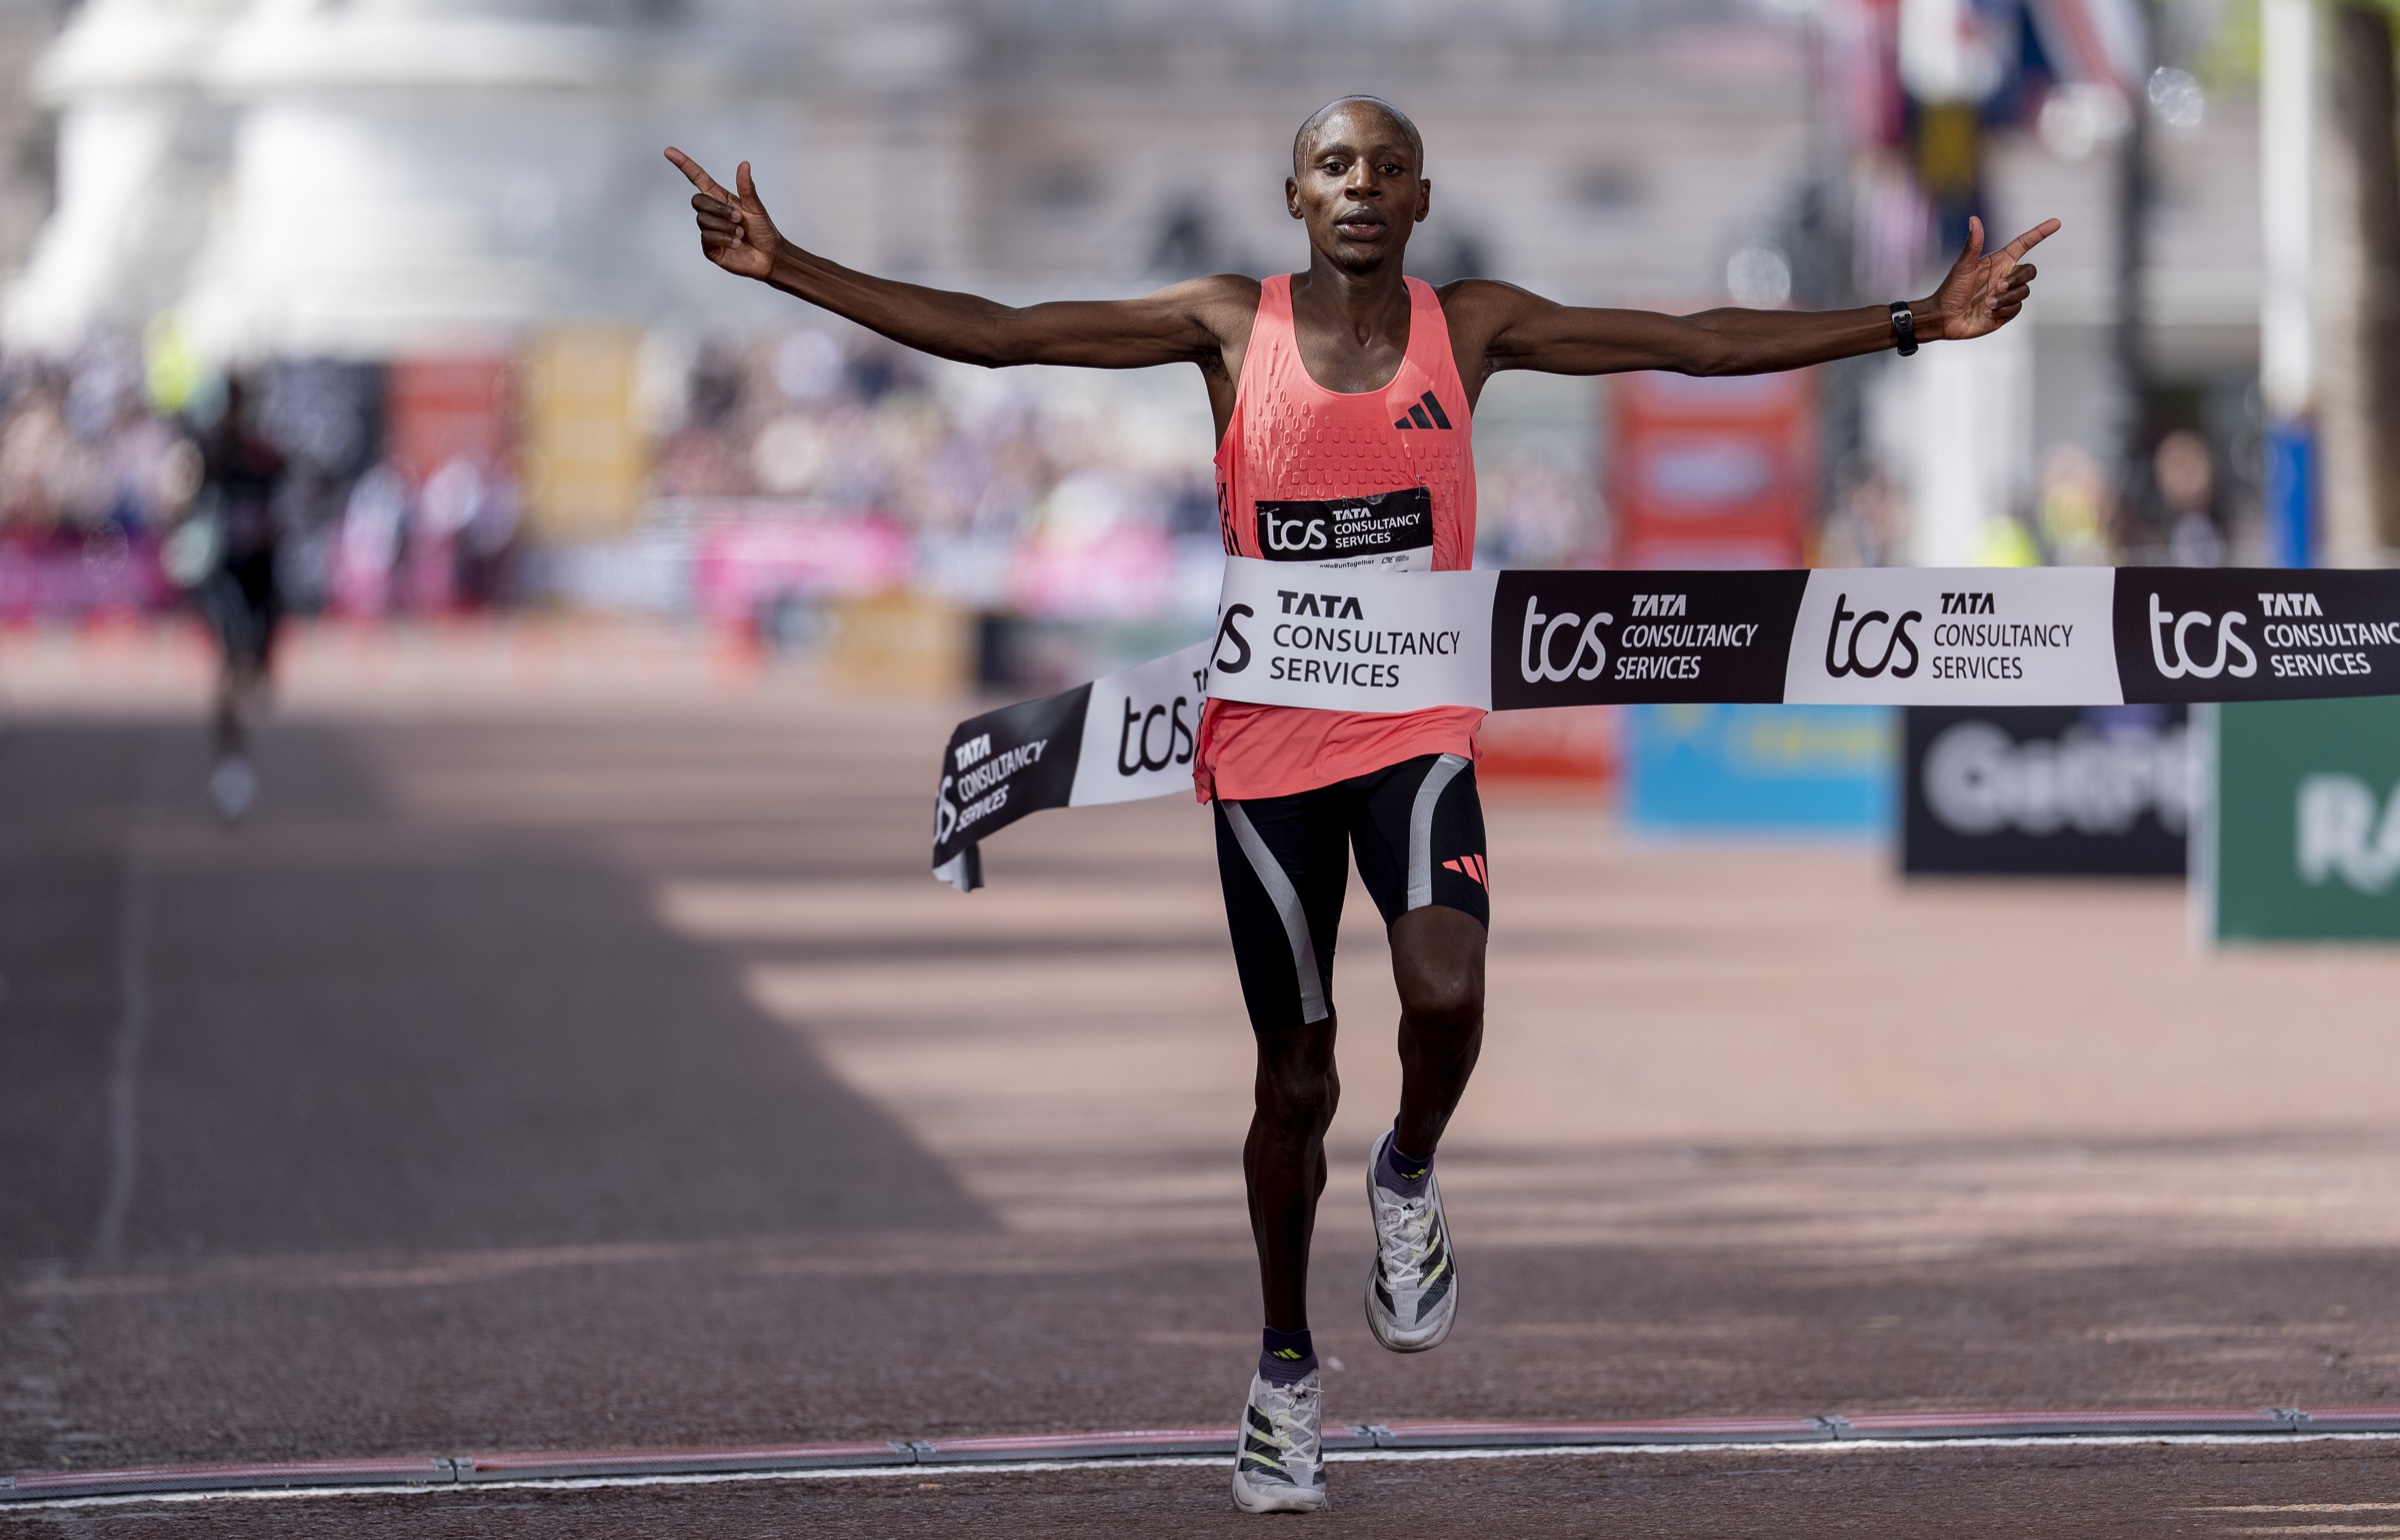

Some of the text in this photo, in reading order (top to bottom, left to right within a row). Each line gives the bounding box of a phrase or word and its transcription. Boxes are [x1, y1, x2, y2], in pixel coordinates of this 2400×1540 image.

[1333, 507, 1371, 521] TATA
[1334, 513, 1421, 535] CONSULTANCY
[1266, 511, 1327, 550] tcs
[1335, 532, 1391, 549] SERVICES
[1277, 590, 1364, 620] TATA
[1631, 594, 1687, 617] TATA
[1940, 592, 1995, 615] TATA
[2257, 593, 2323, 617] TATA
[1272, 623, 1461, 656] CONSULTANCY
[1520, 595, 1614, 684] tcs
[1621, 623, 1759, 648] CONSULTANCY
[1825, 593, 1923, 679] tcs
[1933, 623, 2074, 648] CONSULTANCY
[2149, 592, 2258, 680] tcs
[1269, 656, 1400, 688] SERVICES
[1614, 655, 1702, 680] SERVICES
[1932, 656, 2023, 680] SERVICES
[2270, 652, 2372, 678] SERVICES
[1118, 696, 1194, 776] tcs
[955, 733, 992, 772] TATA
[958, 739, 1048, 803] CONSULTANCY
[955, 784, 1010, 832] SERVICES
